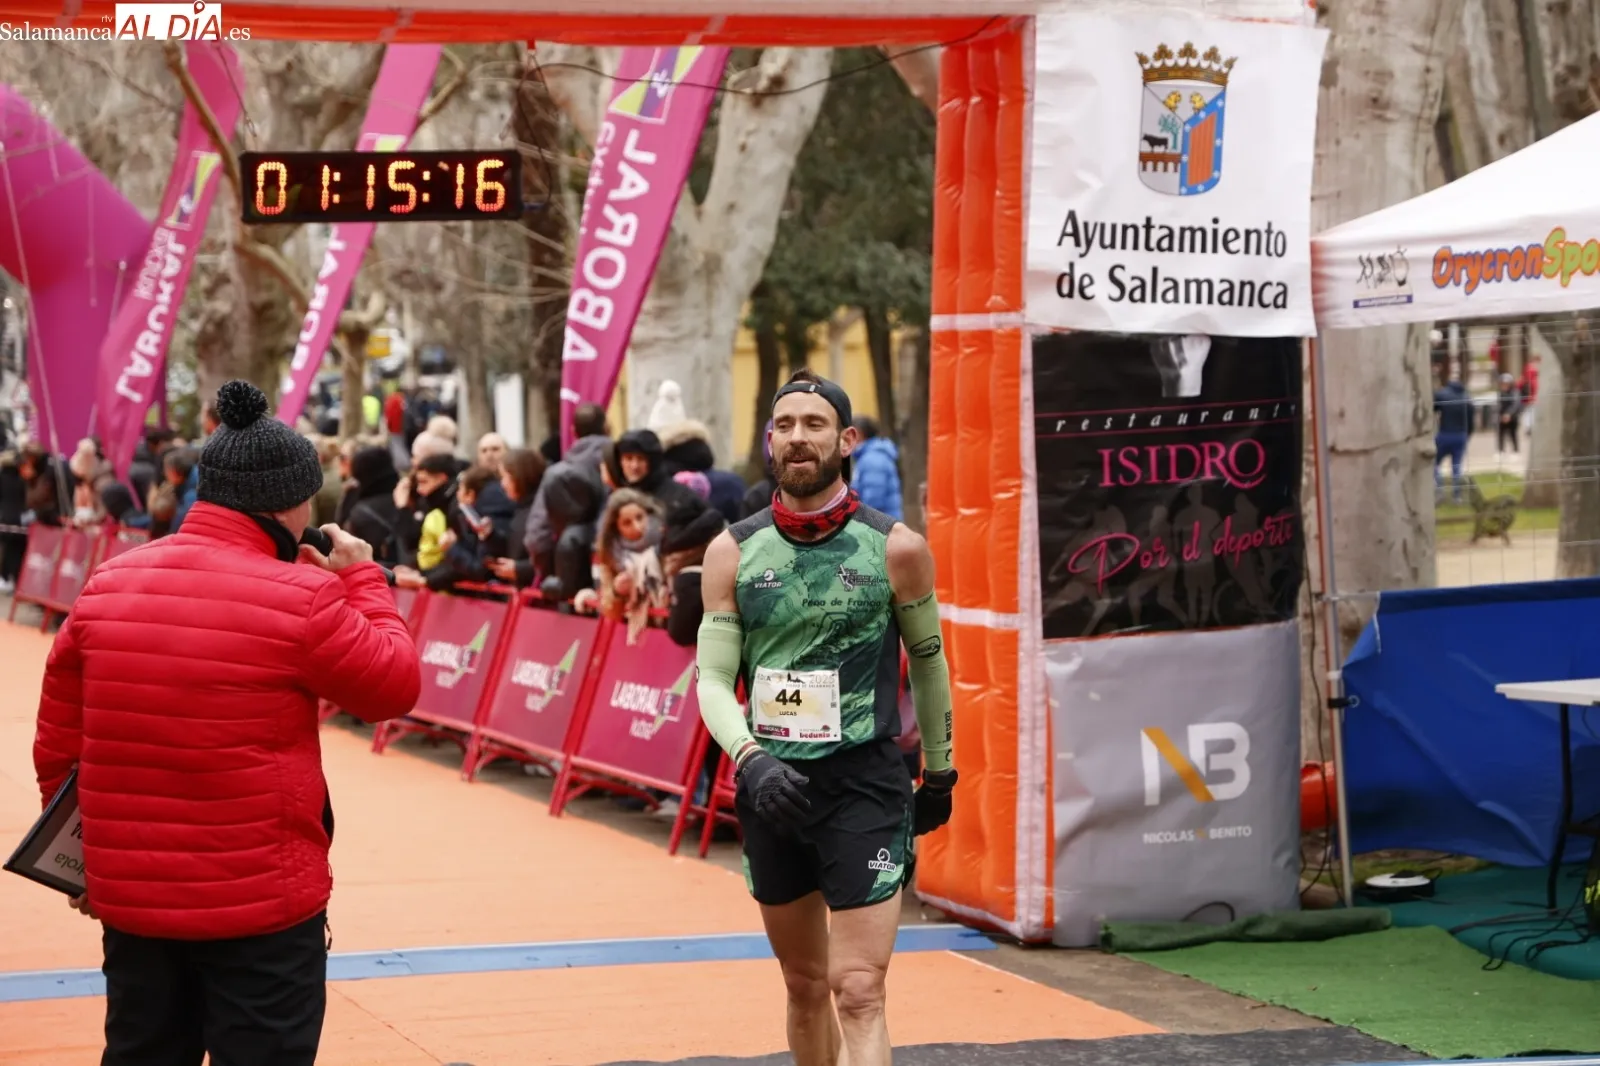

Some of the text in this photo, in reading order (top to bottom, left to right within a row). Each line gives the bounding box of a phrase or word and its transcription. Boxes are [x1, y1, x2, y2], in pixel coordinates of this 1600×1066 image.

[1057, 210, 1287, 258] Ayuntamiento
[1056, 262, 1288, 309] de Salamanca
[1097, 438, 1267, 489] ISIDRO
[1067, 532, 1173, 595] Por
[754, 581, 784, 589] VIATOR
[775, 688, 802, 706] 44
[1143, 830, 1195, 844] NICOLAS
[1209, 825, 1252, 840] BENITO
[868, 860, 897, 873] VIATOR
